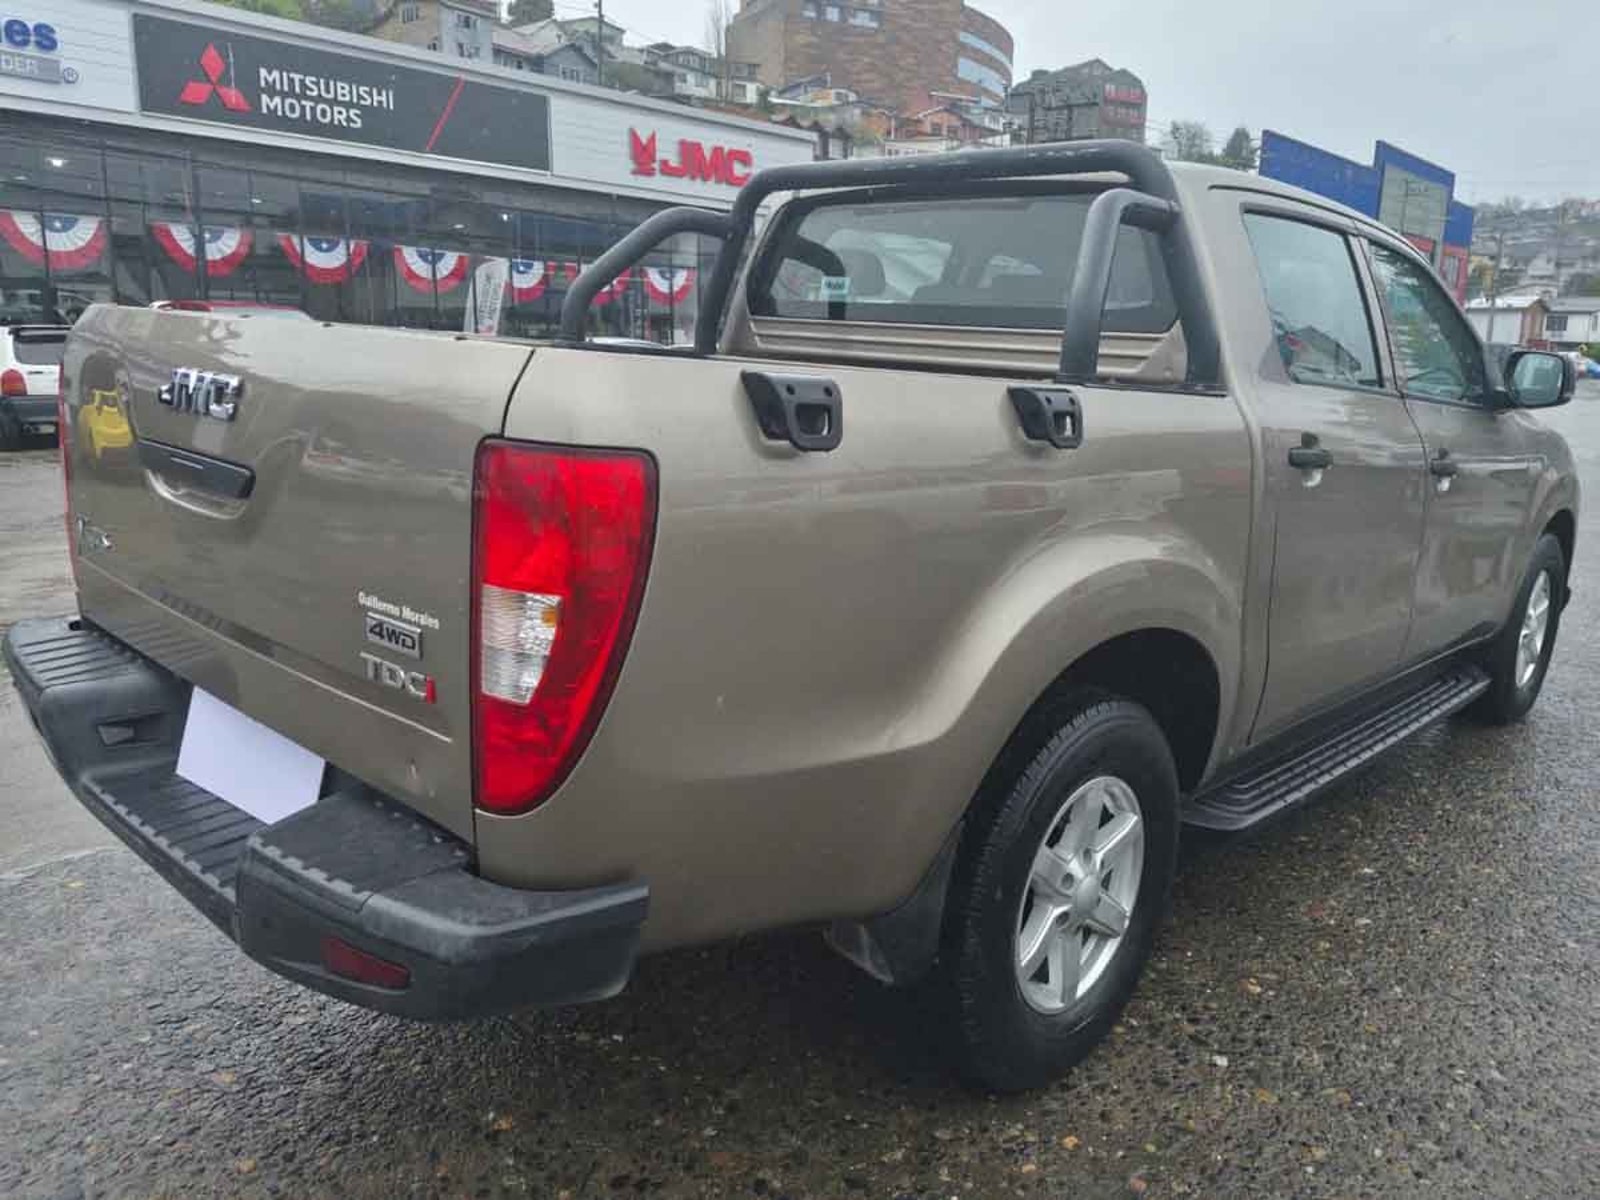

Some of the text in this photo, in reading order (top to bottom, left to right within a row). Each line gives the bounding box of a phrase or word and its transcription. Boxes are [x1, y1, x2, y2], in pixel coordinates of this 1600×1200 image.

[0, 19, 58, 51] es
[259, 66, 395, 111] MITSUBISHI
[260, 92, 363, 129] MOTORS
[659, 138, 754, 188] JMC
[157, 367, 242, 422] JMC
[368, 621, 417, 651] 4WD
